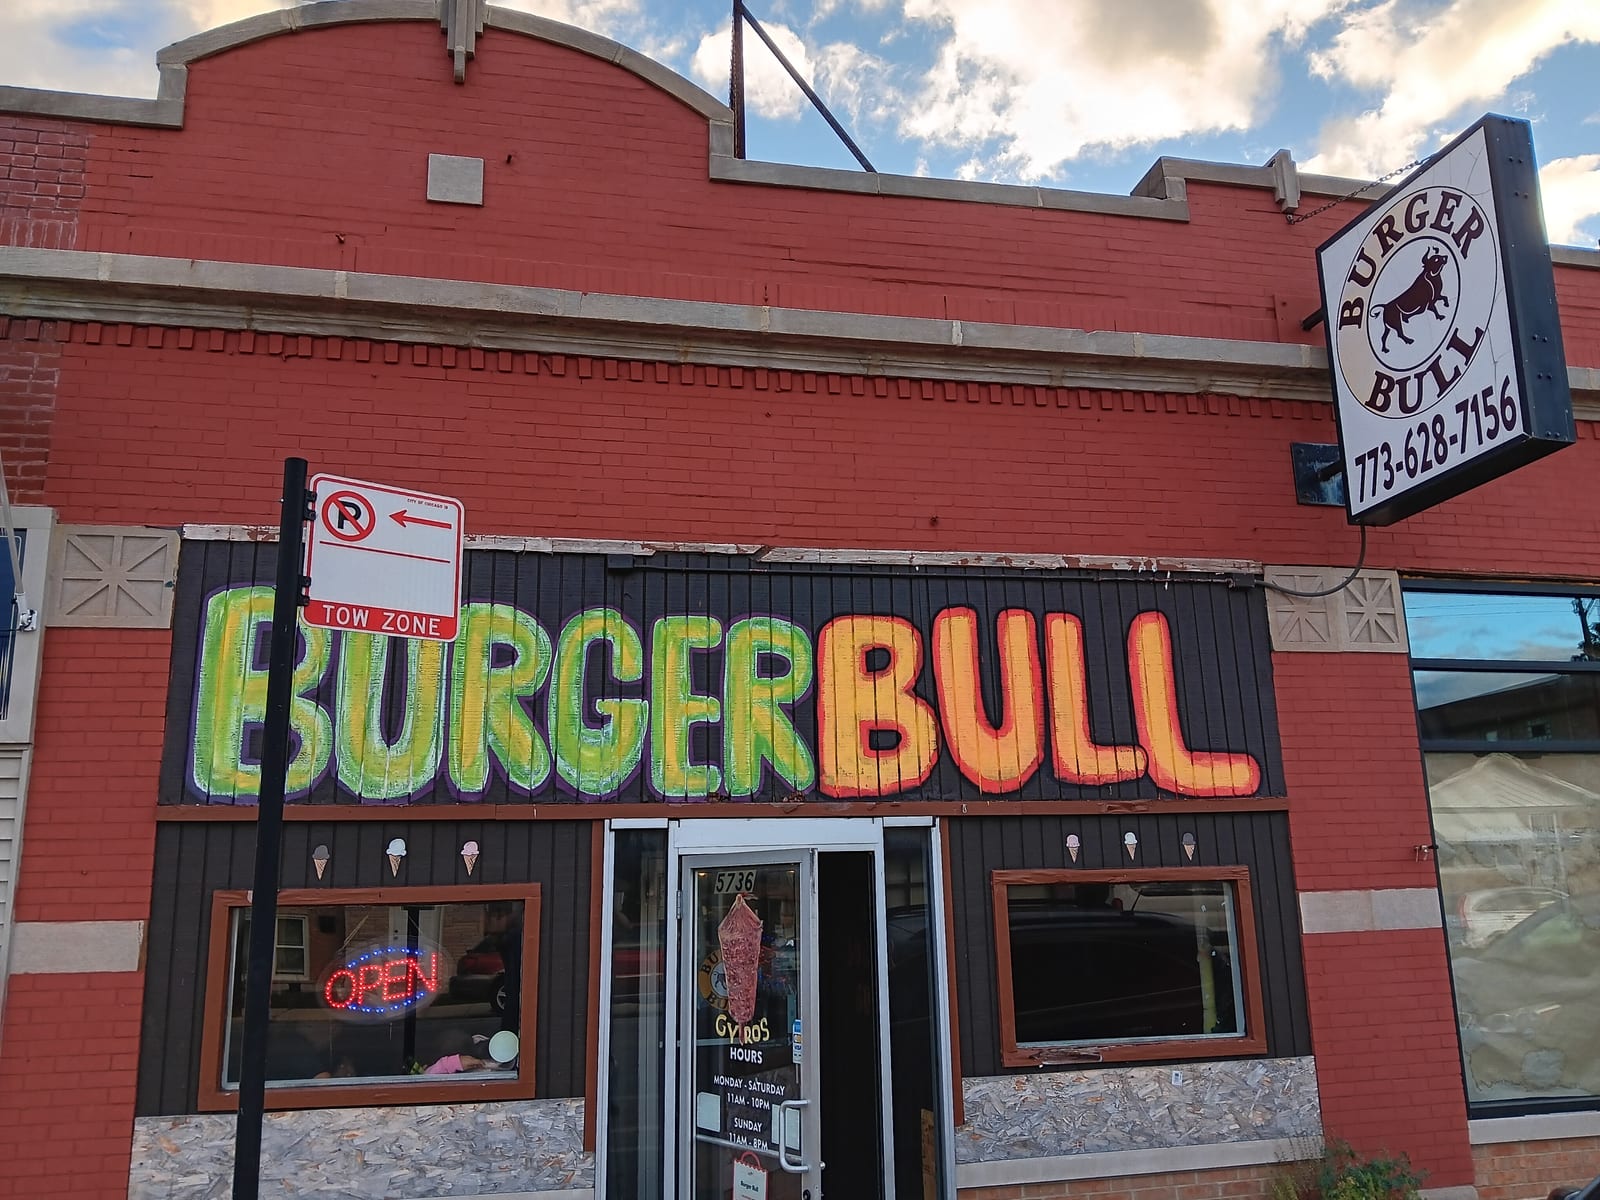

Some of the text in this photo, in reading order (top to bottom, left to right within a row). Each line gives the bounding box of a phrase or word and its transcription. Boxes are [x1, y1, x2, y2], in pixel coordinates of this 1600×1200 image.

[1339, 190, 1485, 331] BURGER
[1365, 326, 1485, 415] BULL
[1354, 375, 1517, 503] 773-628-7156
[424, 501, 443, 509] CHICAGO
[322, 604, 441, 636] TOW ZONE
[716, 871, 754, 893] 5736
[325, 951, 438, 1009] OPEN
[730, 1046, 763, 1065] HOURS
[713, 1074, 743, 1089] MONDAY
[748, 1080, 786, 1097] SATURDAY
[727, 1092, 746, 1106] 11AM
[751, 1097, 770, 1111] 10PM
[734, 1117, 762, 1133] SUNDAY
[729, 1132, 747, 1146] 11AM
[753, 1138, 769, 1150] 8PM
